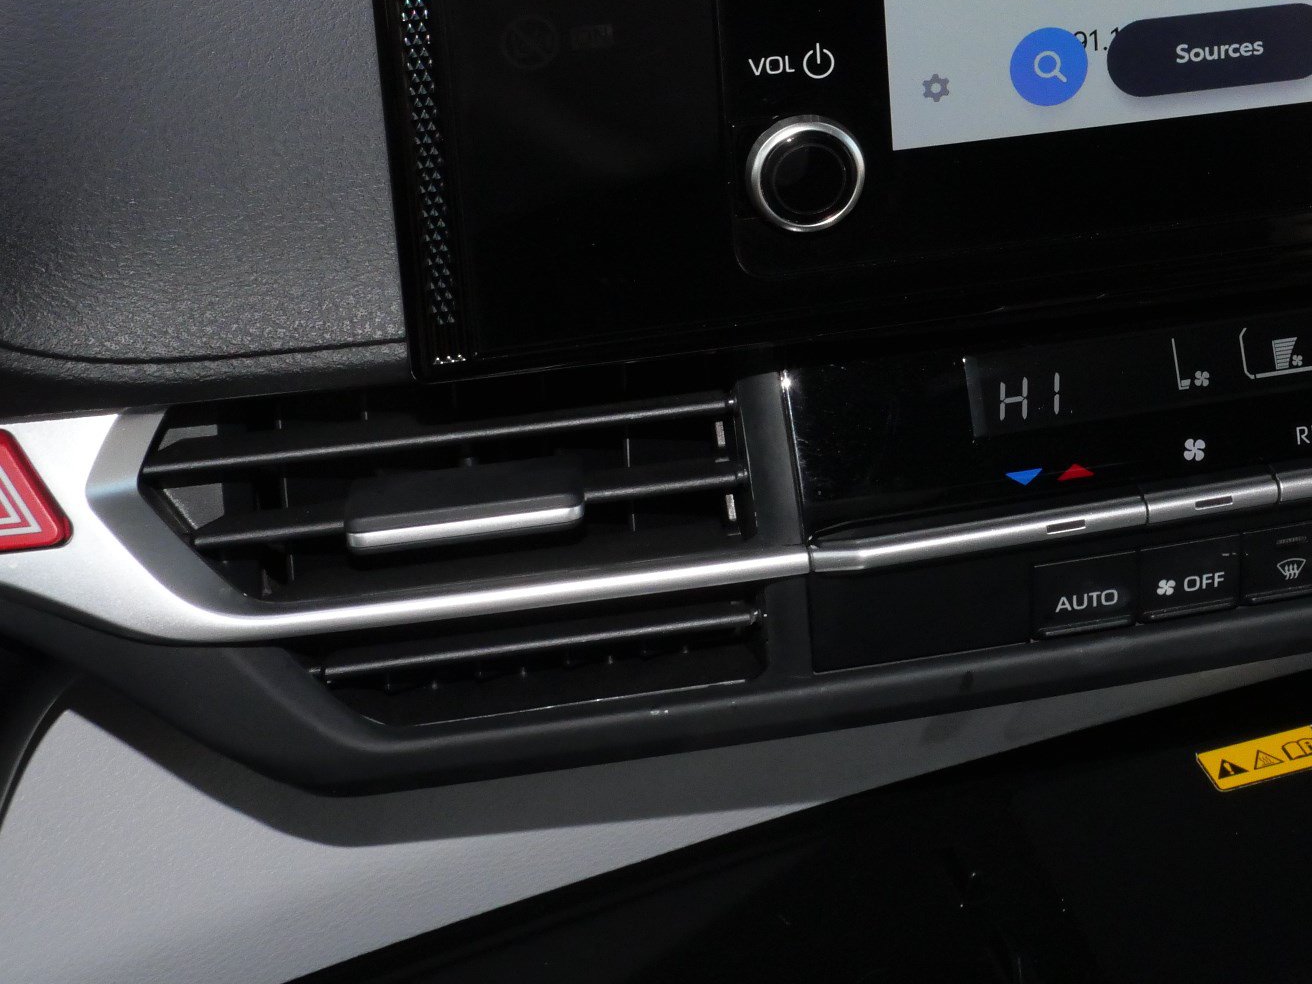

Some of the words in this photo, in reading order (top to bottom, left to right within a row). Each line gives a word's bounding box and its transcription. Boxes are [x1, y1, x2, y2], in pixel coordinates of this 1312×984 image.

[1175, 40, 1264, 64] Sources
[748, 56, 796, 76] VOL
[1184, 572, 1225, 591] OFF
[1055, 589, 1119, 612] AUTO
